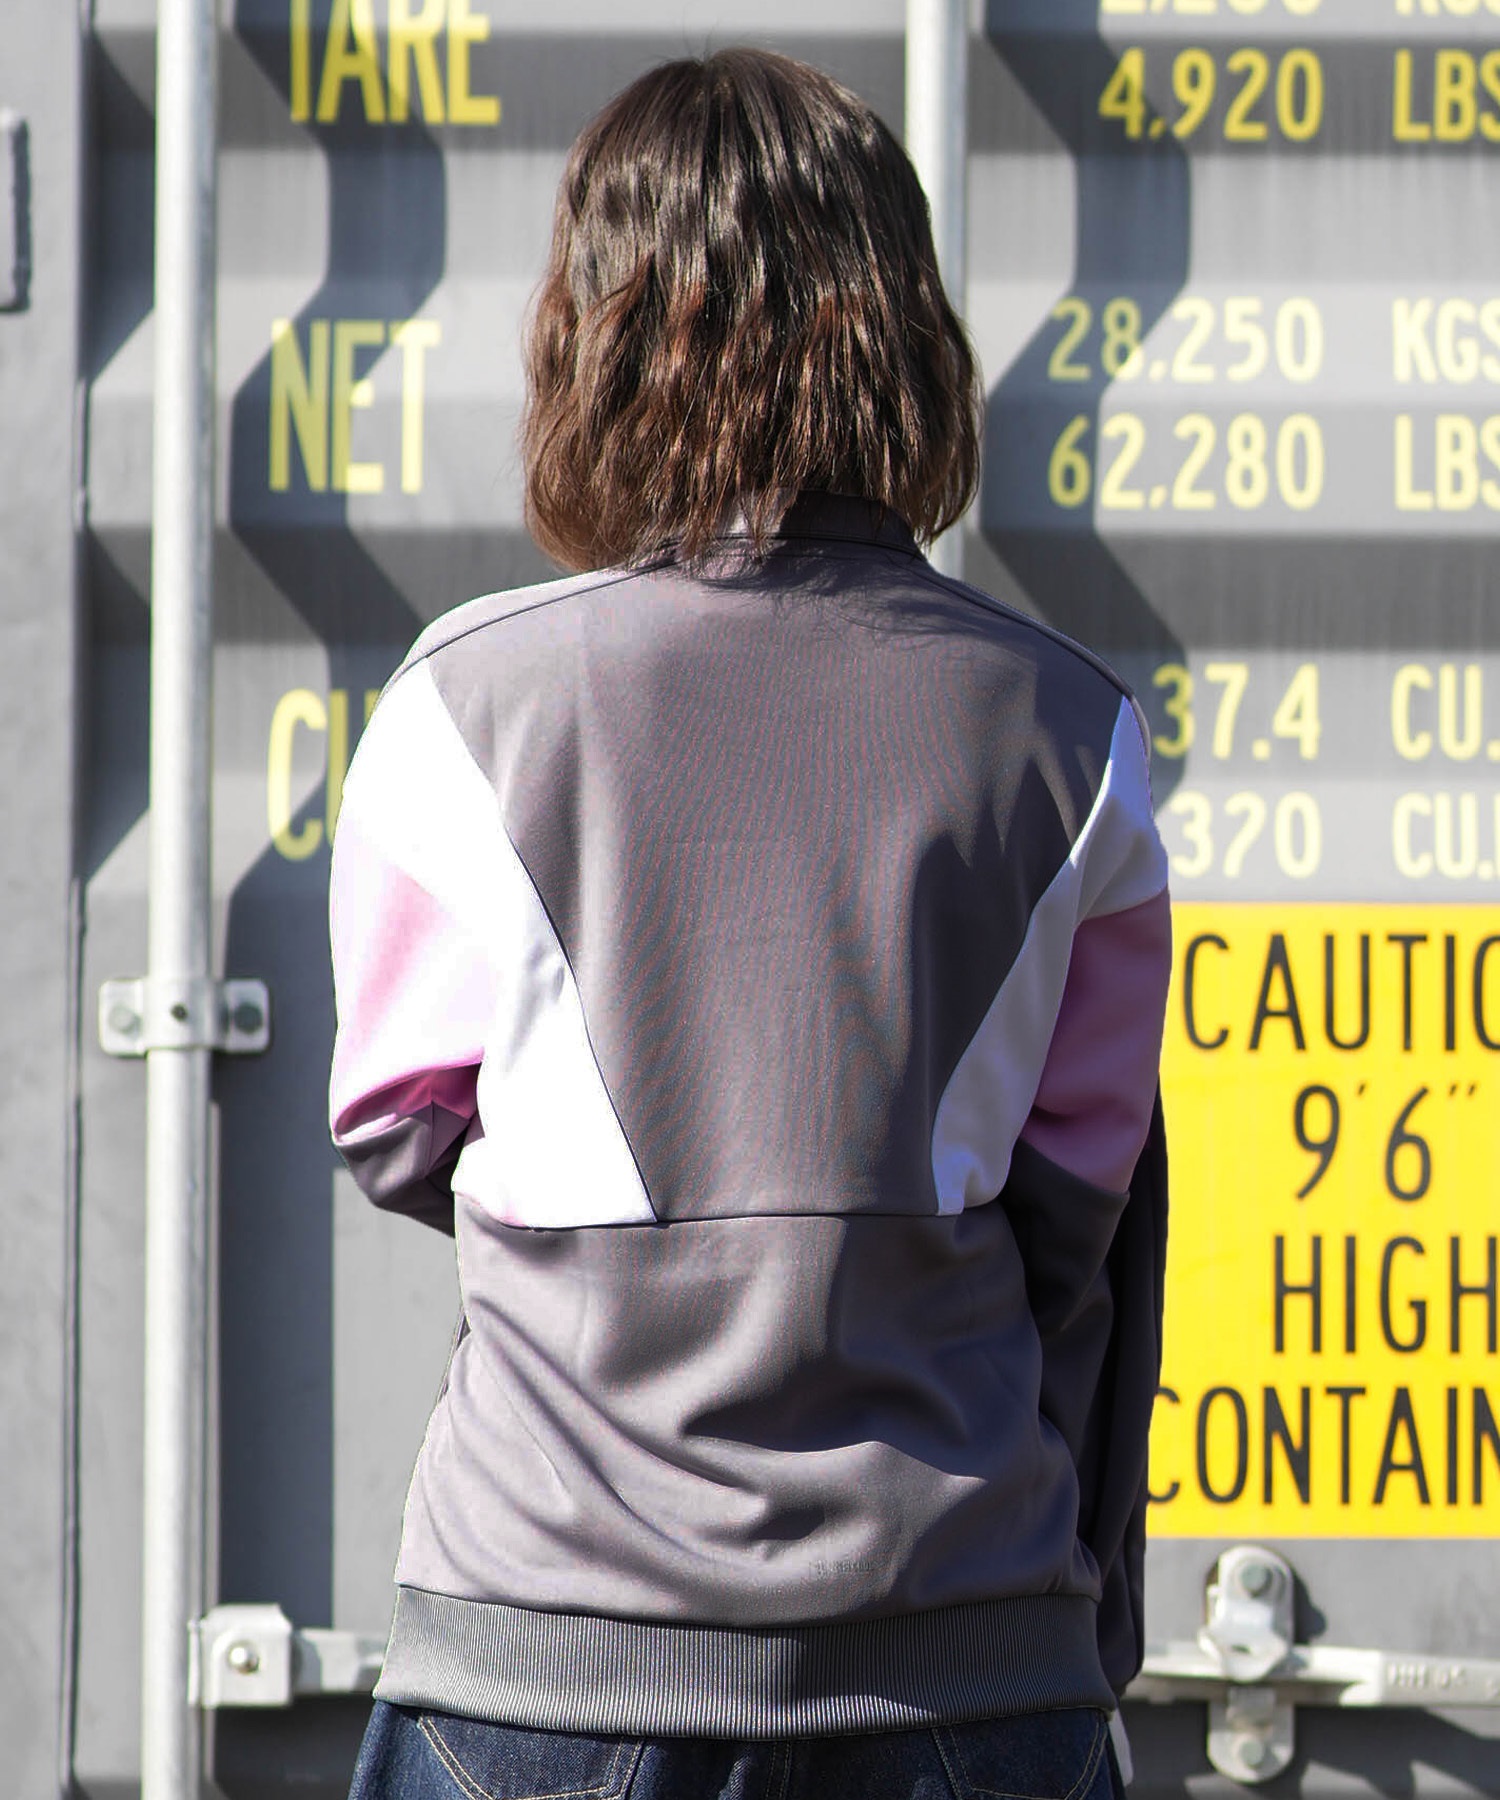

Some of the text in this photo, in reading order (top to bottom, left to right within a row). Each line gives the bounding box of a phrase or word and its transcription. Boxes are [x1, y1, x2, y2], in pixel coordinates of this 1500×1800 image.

[269, 319, 441, 494] NET
[1153, 663, 1320, 760] 37.4
[1392, 792, 1500, 880] CU.
[1274, 1235, 1497, 1354] HIGH
